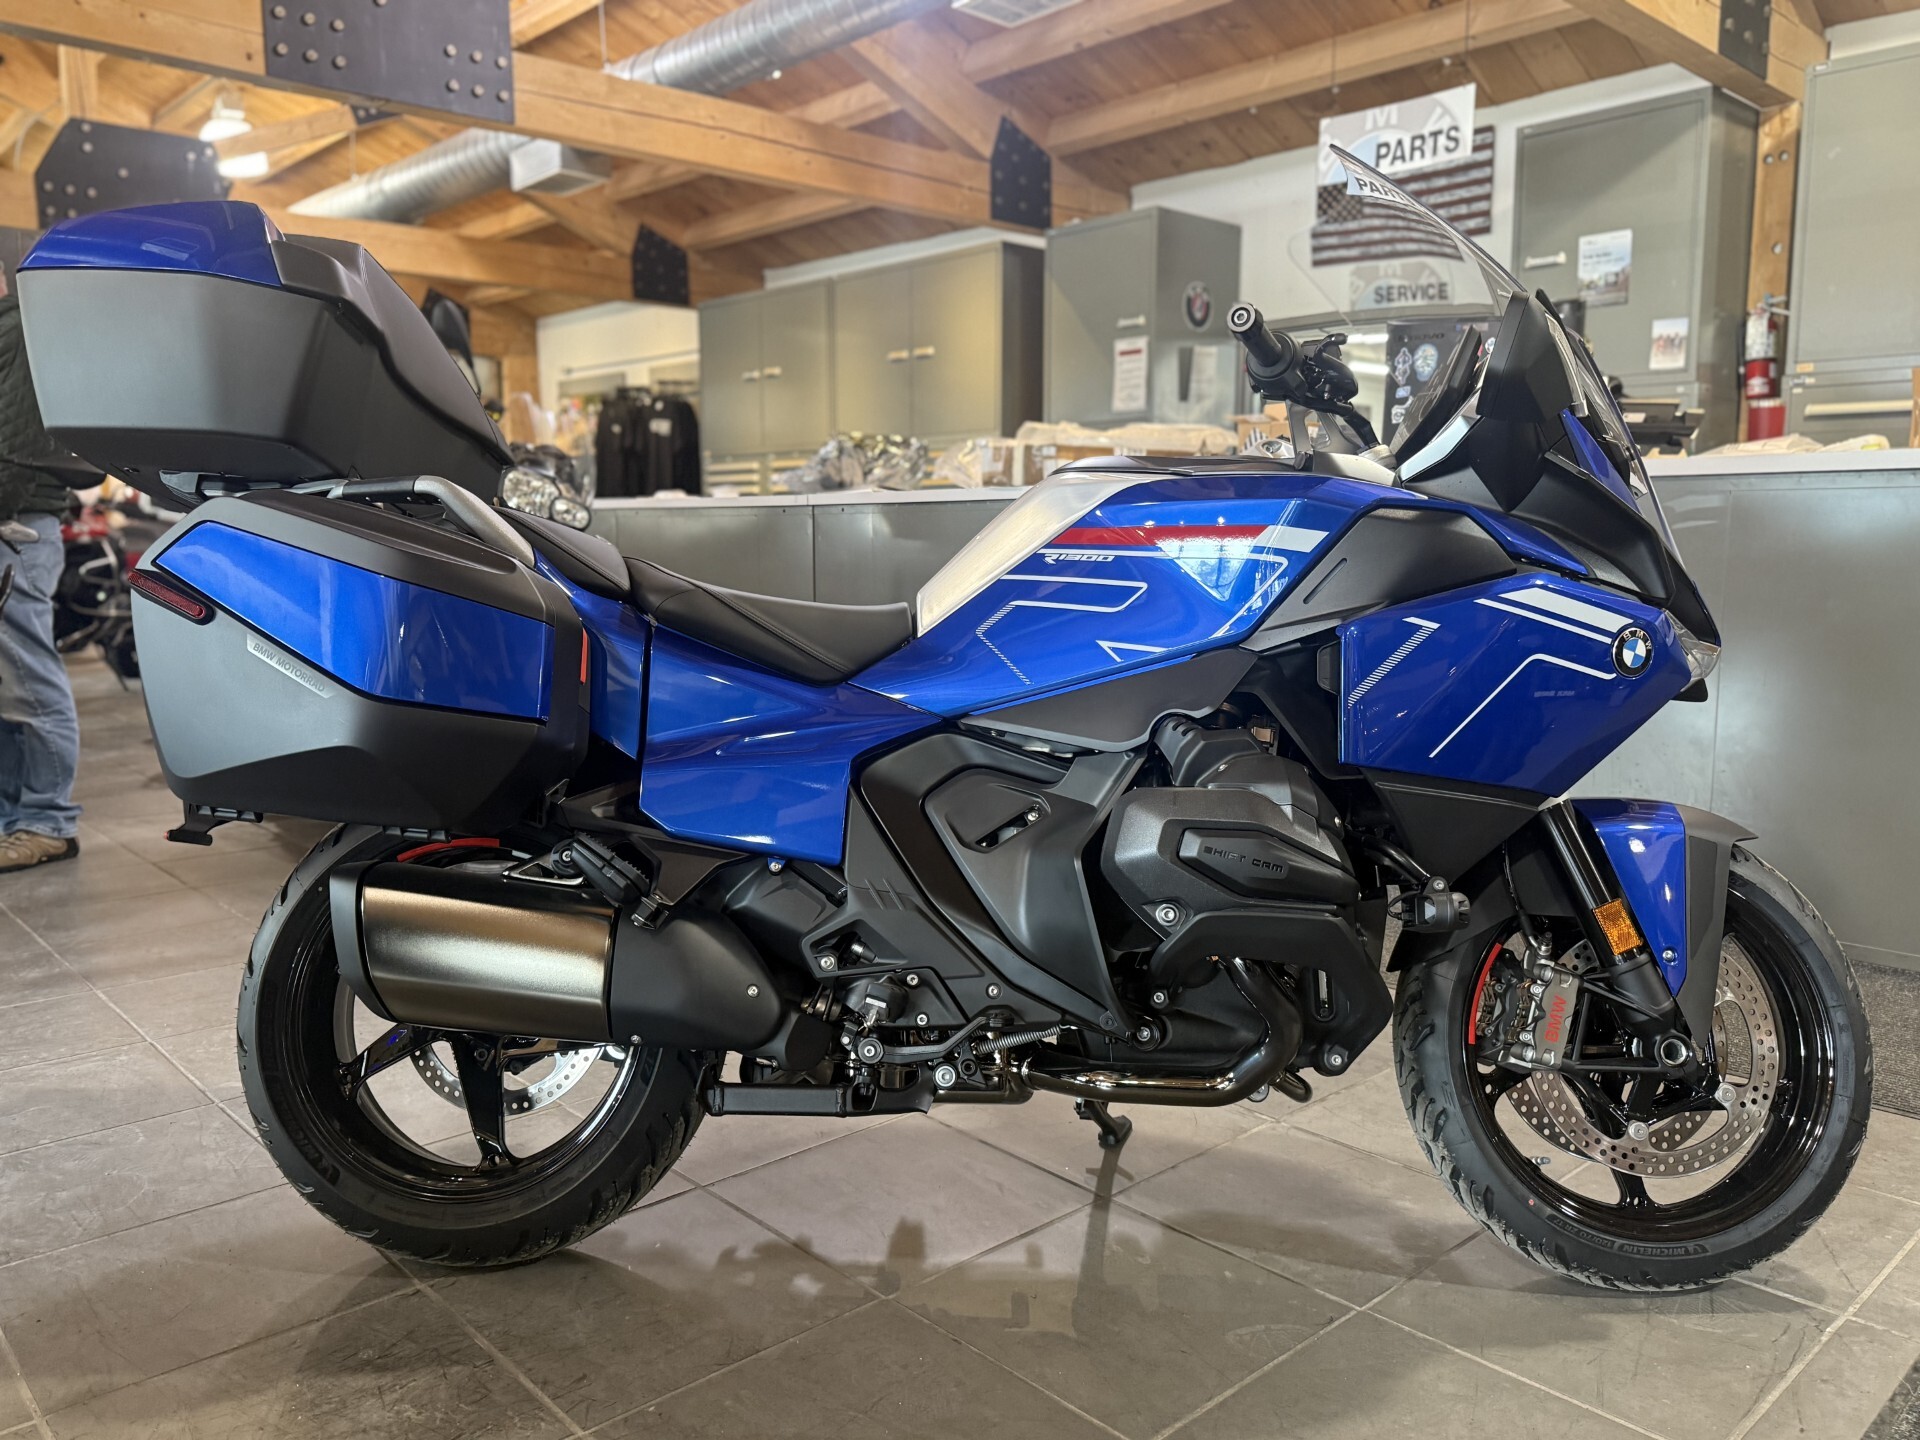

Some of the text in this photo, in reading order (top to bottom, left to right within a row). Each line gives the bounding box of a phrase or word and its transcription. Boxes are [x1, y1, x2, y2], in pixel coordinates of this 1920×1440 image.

[1375, 126, 1460, 168] PARTS
[1374, 282, 1449, 304] SERVICE
[253, 643, 325, 692] BMW MOTORRAD
[1203, 846, 1284, 873] SHIFT CAM
[1544, 993, 1567, 1043] BMW
[1623, 1245, 1686, 1257] MICHELIN
